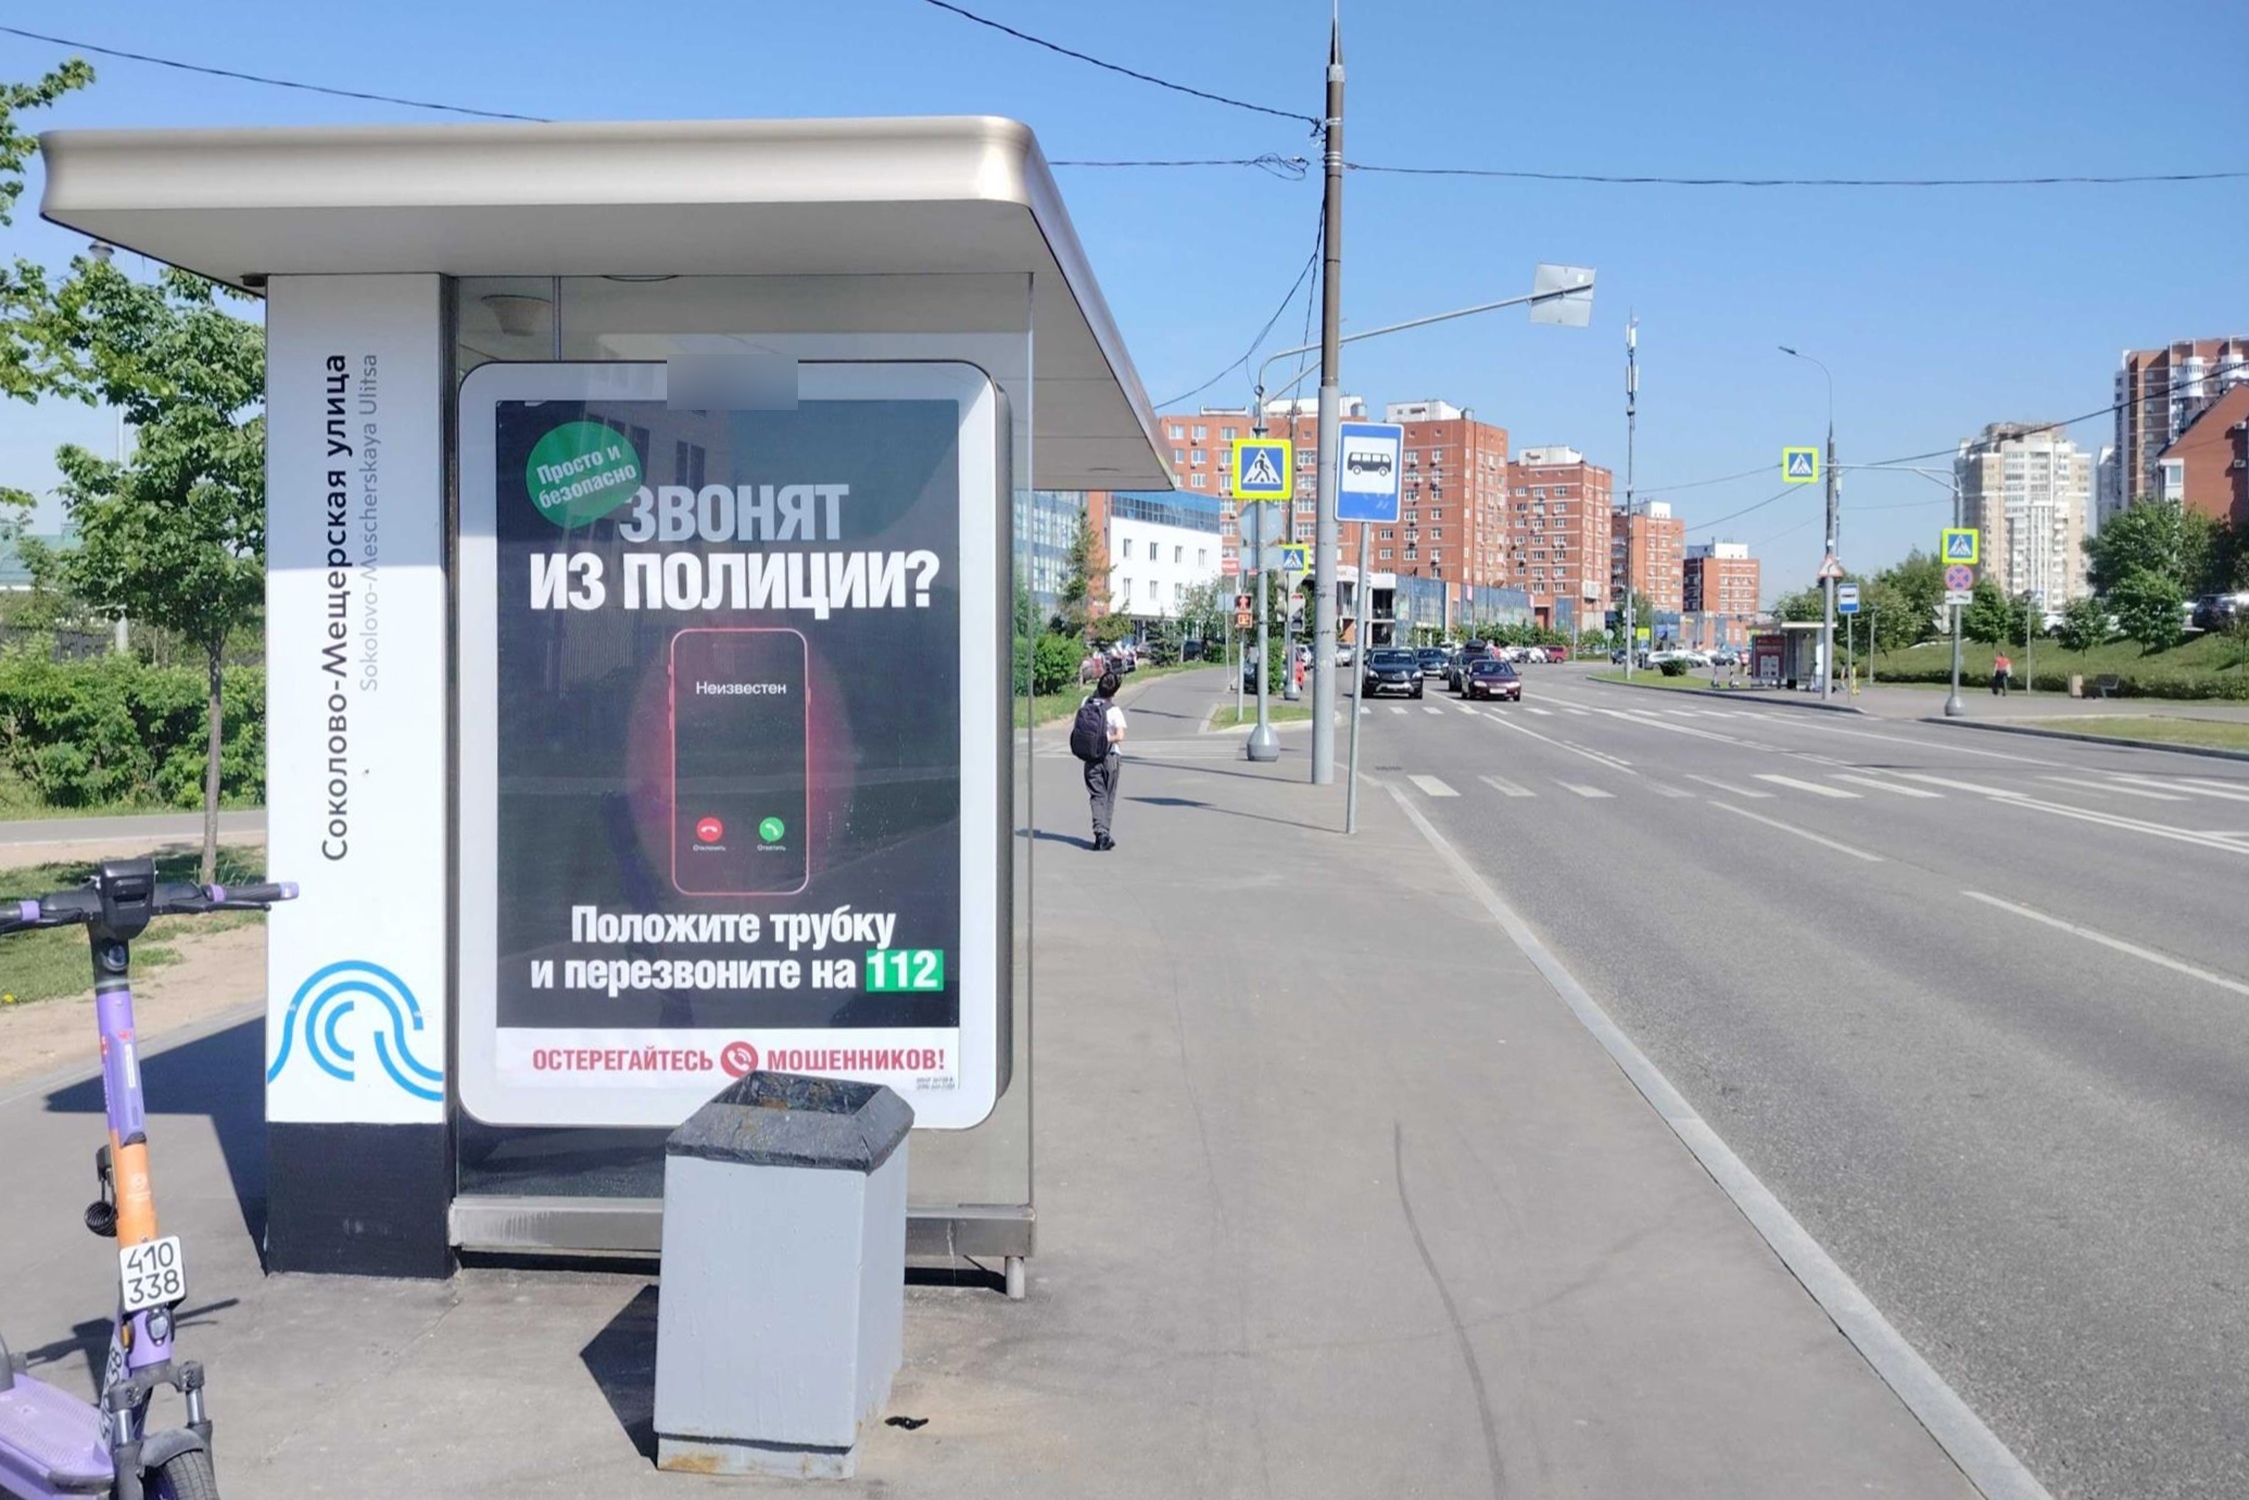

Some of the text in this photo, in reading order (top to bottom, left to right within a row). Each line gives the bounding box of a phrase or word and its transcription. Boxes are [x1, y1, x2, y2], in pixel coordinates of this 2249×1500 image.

[536, 445, 621, 485] Просто и
[539, 464, 637, 509] безопасно
[358, 354, 378, 692] Sokolovo-Mescherskaya Ulitsa
[619, 484, 849, 542] ЗВОНЯТ
[530, 550, 940, 619] ИЗ ПОЛИЦИИ?
[321, 354, 353, 861] Соколово-Мещерская улица
[696, 682, 787, 695] Неизвестен
[571, 906, 897, 950] Положите трубку
[531, 951, 939, 998] и перезвоните на 112
[532, 1045, 946, 1071] ОСТЕРЕГАЙТЕСЬ МОШЕННИКОВ!
[126, 1242, 175, 1274] 410
[128, 1269, 181, 1304] 338
